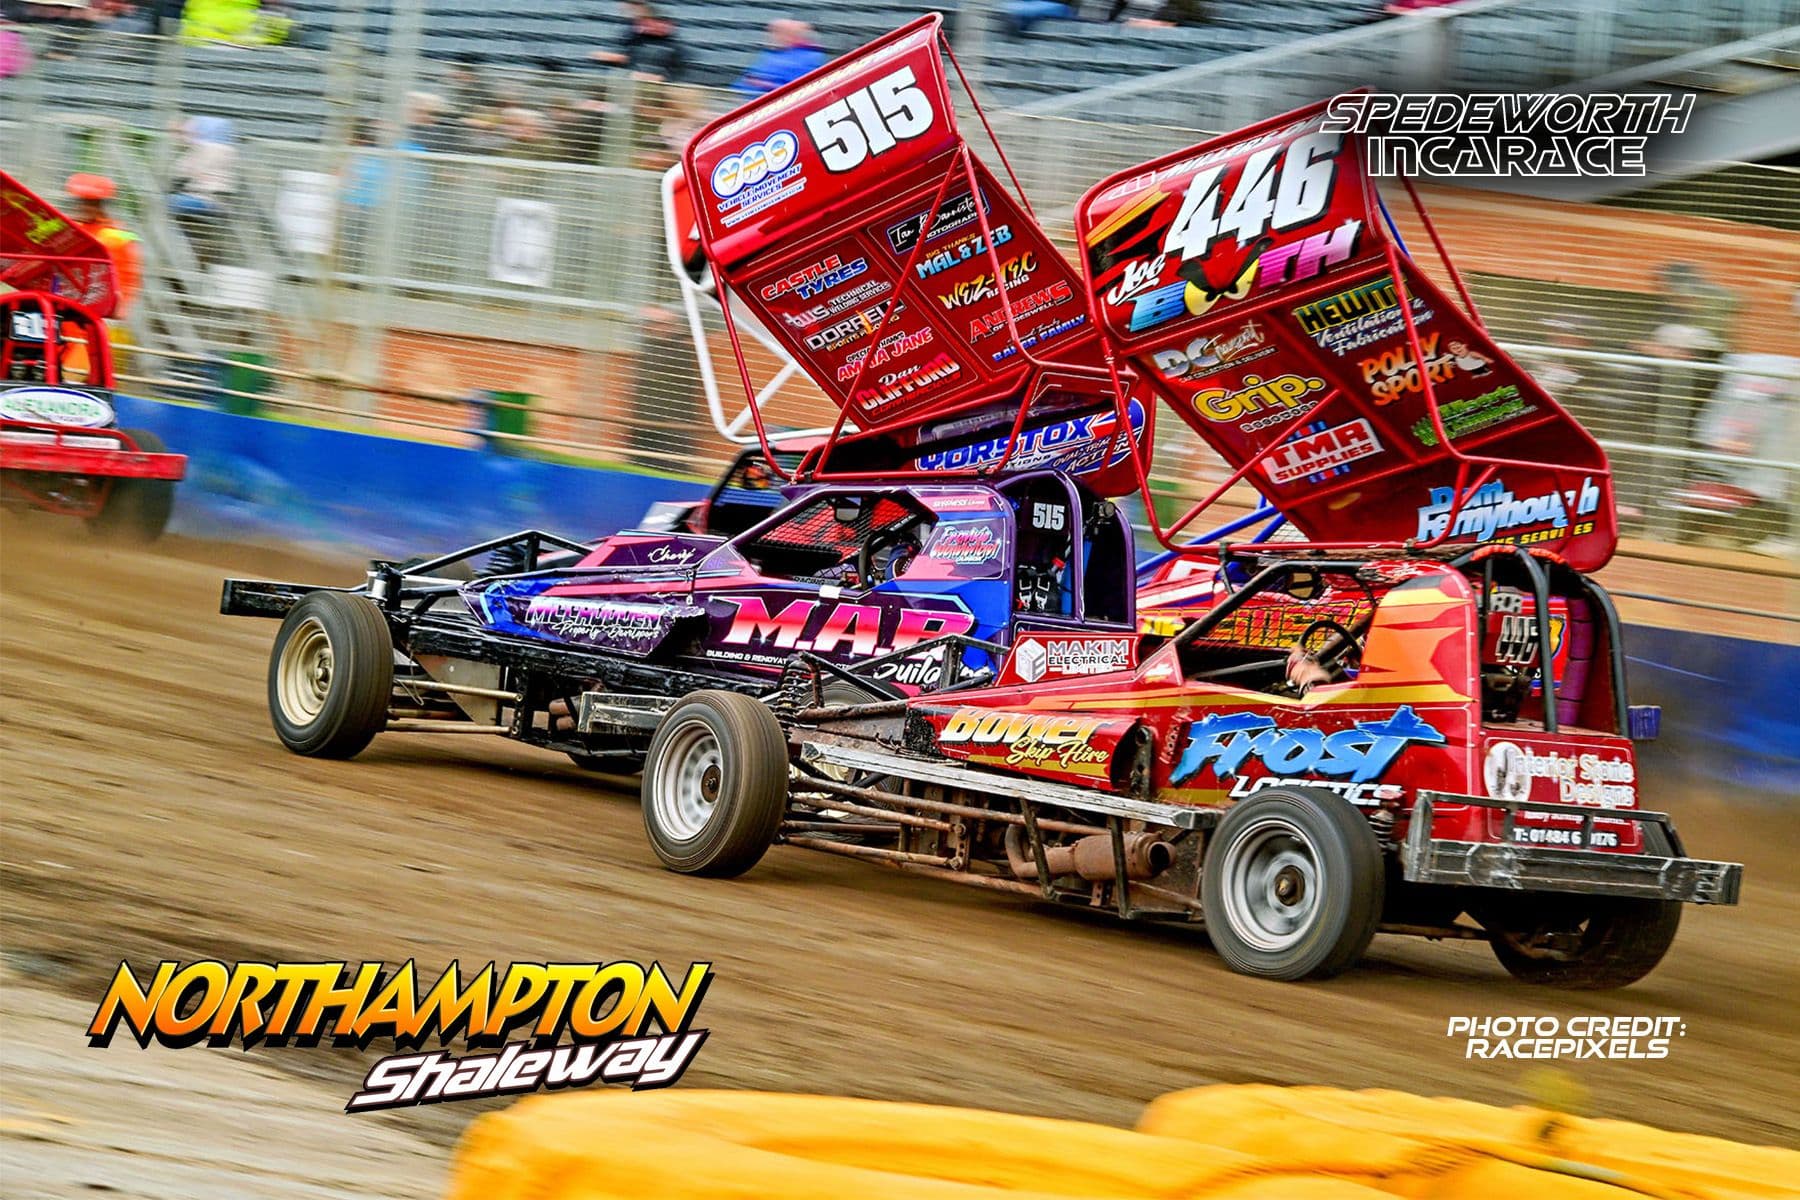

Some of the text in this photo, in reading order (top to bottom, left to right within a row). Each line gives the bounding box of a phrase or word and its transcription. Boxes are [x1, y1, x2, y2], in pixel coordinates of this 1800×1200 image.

[804, 65, 934, 172] 515
[718, 187, 754, 211] VEHICLE
[754, 164, 802, 195] MOVEMENT
[741, 184, 782, 208] SERVICES
[1164, 131, 1344, 261] 446
[889, 223, 915, 247] Ian
[916, 251, 960, 280] MAL
[958, 243, 972, 260] &
[761, 254, 842, 301] CASTLE
[796, 257, 868, 300] TYRES
[1107, 253, 1167, 307] Joe
[892, 326, 933, 357] JANE
[1040, 314, 1086, 341] FAMILY
[855, 352, 961, 411] CLIFFORD
[878, 363, 921, 386] Dan
[1271, 421, 1369, 468] TMR
[1274, 442, 1374, 481] SUPPLIES
[1032, 502, 1065, 531] 515
[1520, 522, 1594, 545] SERVIES
[553, 620, 603, 642] Property
[706, 650, 743, 662] BUILDING
[744, 653, 751, 662] &
[1047, 640, 1129, 656] MAKIM
[1048, 655, 1128, 666] ELECTRICAL
[1005, 736, 1110, 771] Skip Hire
[1169, 704, 1446, 786] Frost
[1560, 777, 1635, 808] Designs
[1513, 828, 1529, 842] T:
